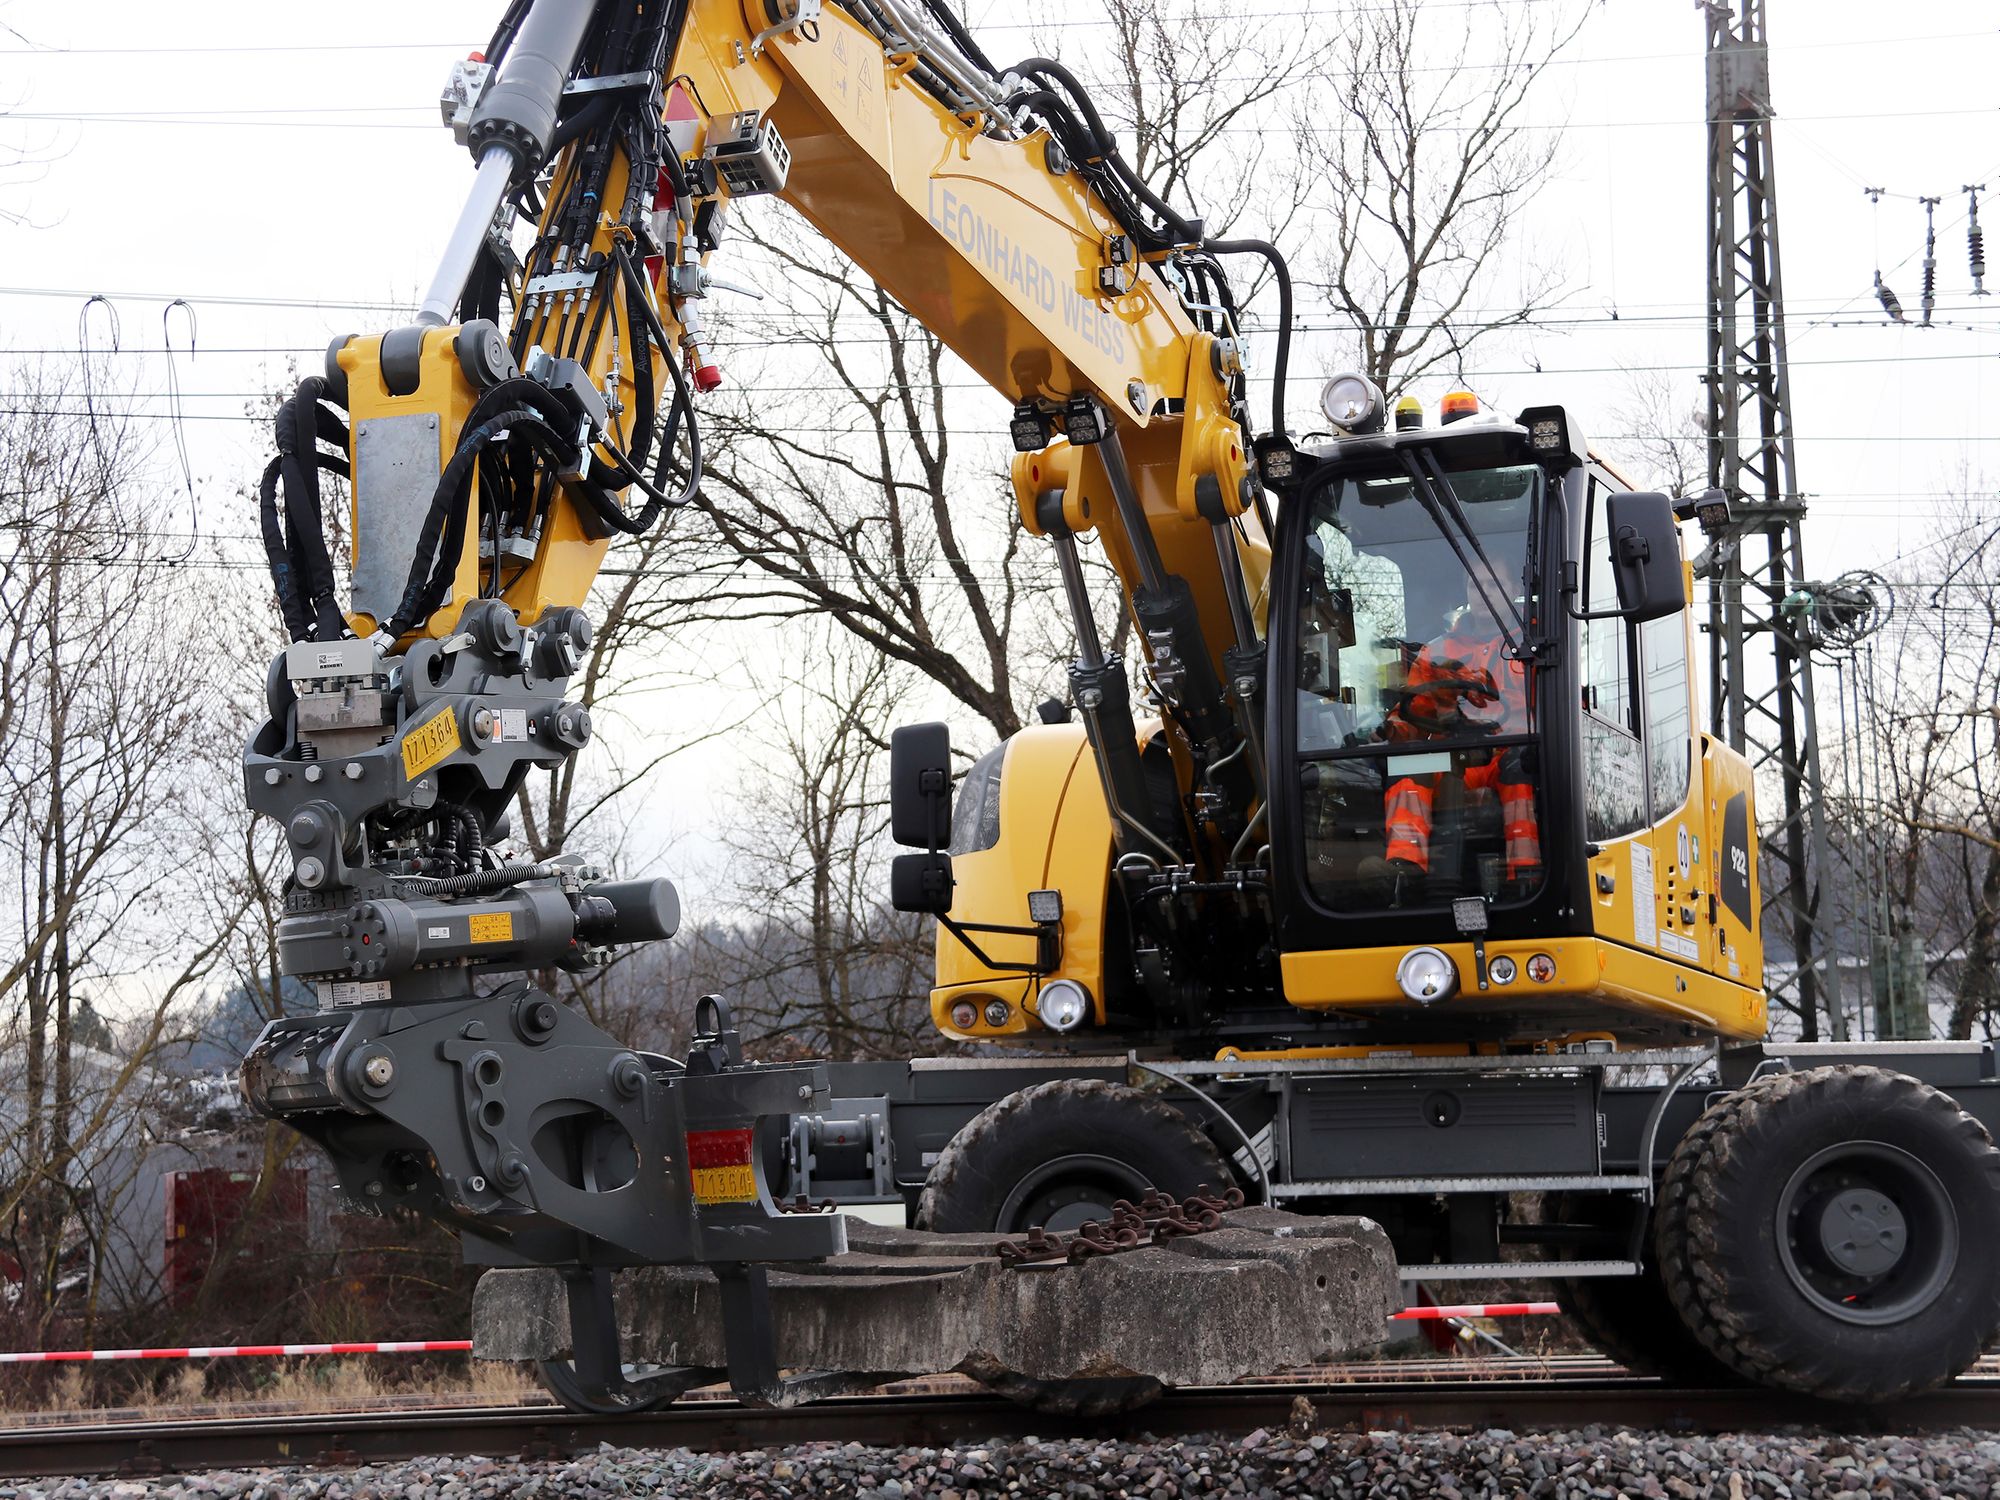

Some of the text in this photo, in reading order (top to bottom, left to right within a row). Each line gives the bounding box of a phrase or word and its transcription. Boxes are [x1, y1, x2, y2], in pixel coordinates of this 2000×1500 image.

[928, 178, 1125, 365] LEONHARD WEISS
[634, 326, 648, 375] Aeroquip
[1679, 831, 1688, 869] 20
[1731, 845, 1747, 876] 922
[697, 1172, 747, 1195] 71364
